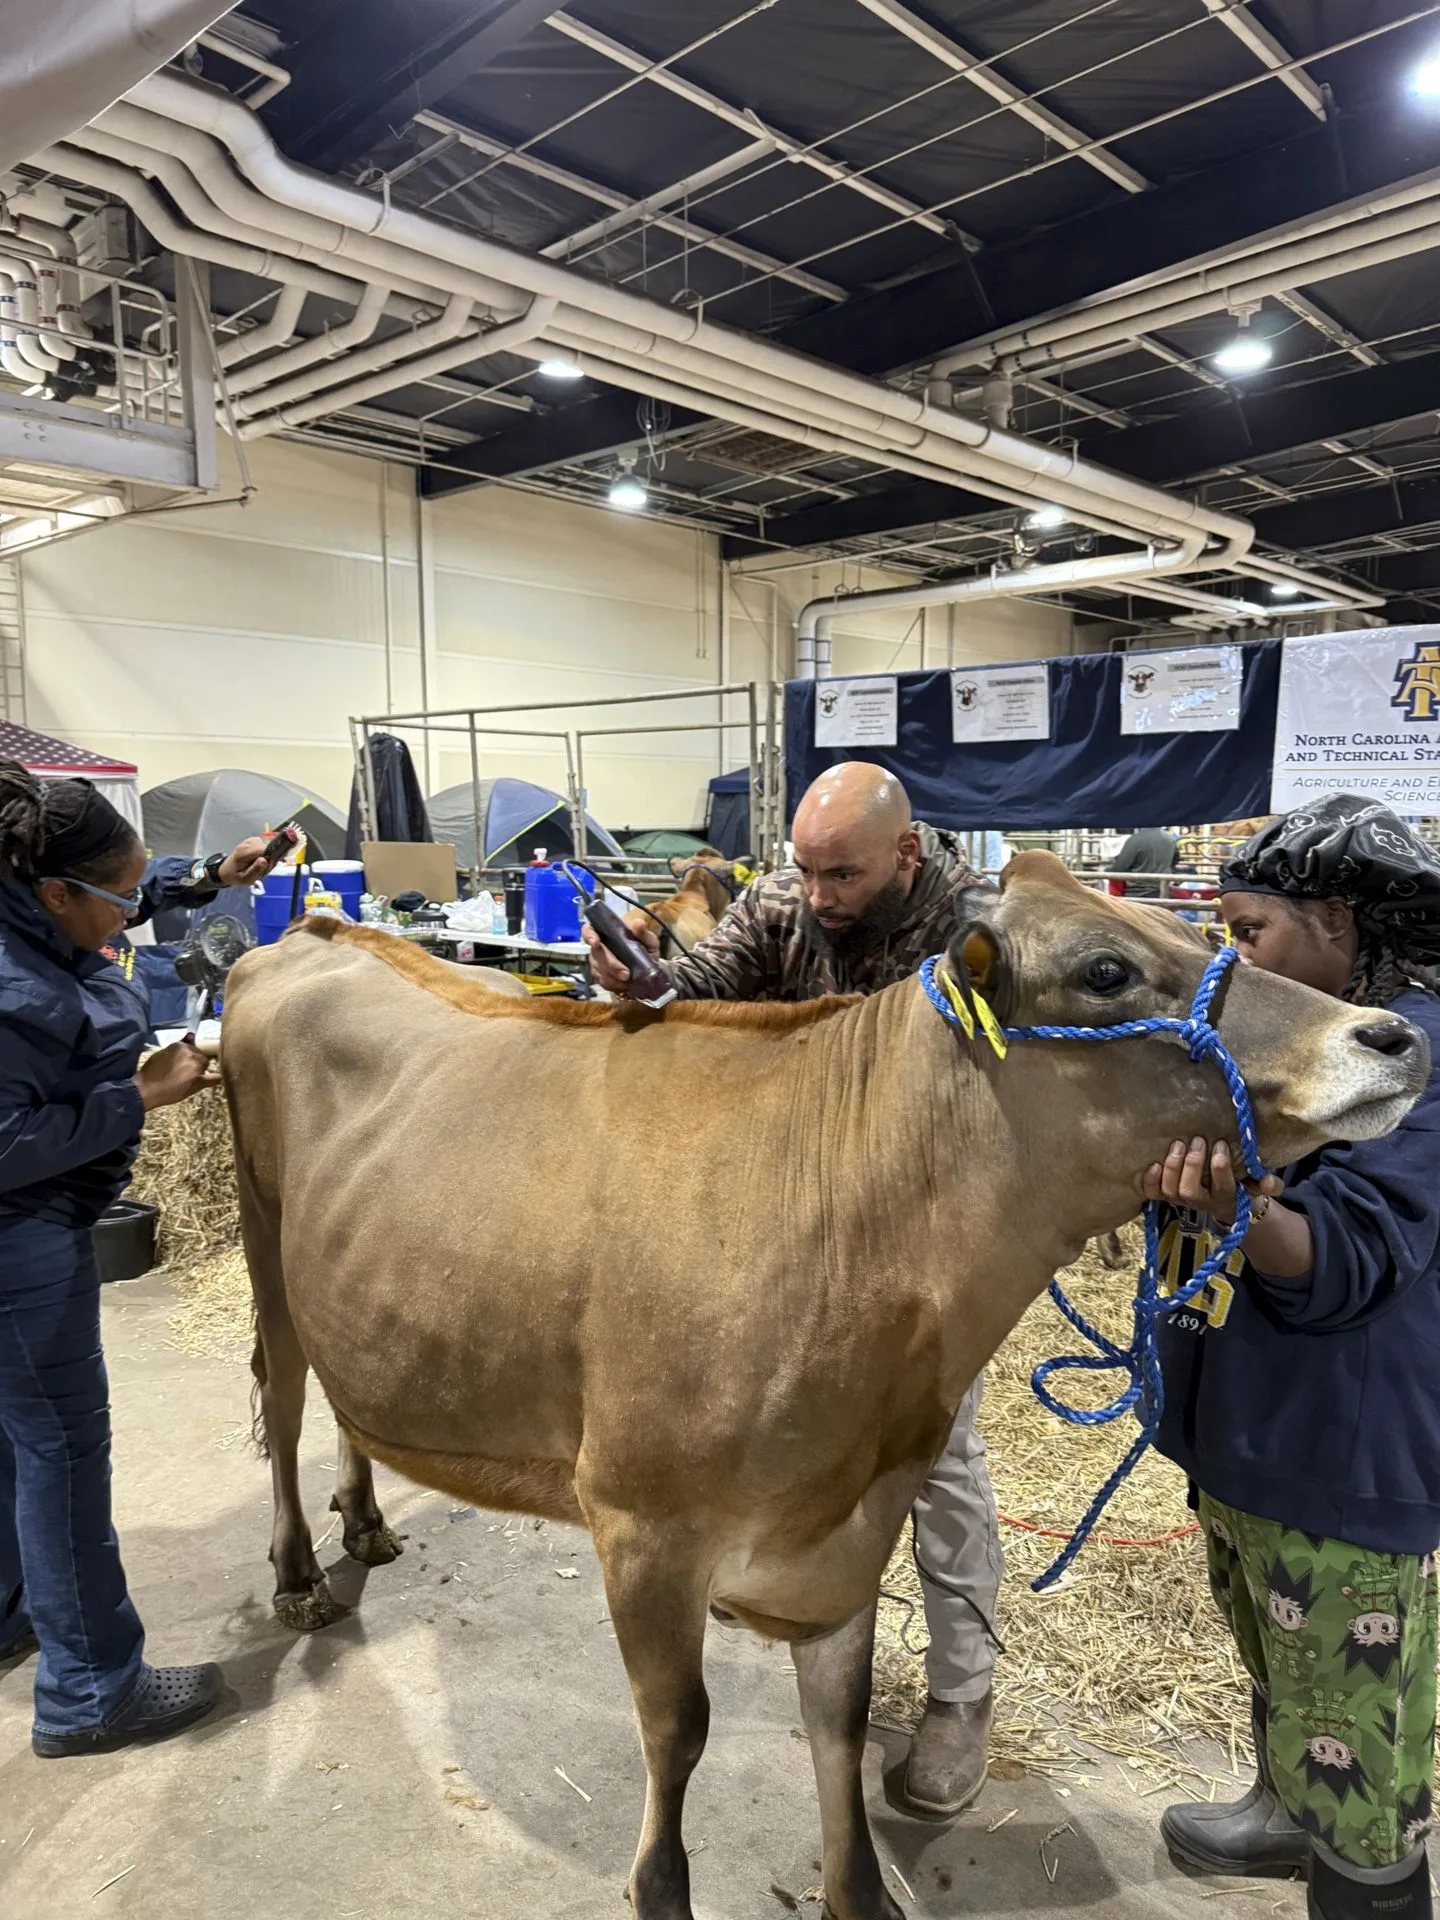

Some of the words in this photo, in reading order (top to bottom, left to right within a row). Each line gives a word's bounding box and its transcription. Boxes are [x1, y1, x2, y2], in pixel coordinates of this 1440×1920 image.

[1295, 734, 1346, 746] NORTH
[1352, 733, 1430, 745] CAROLINA
[1285, 752, 1317, 761] AND
[1323, 750, 1408, 761] TECHNICAL
[1292, 777, 1389, 788] AGRICULTURE
[1391, 778, 1423, 788] AND
